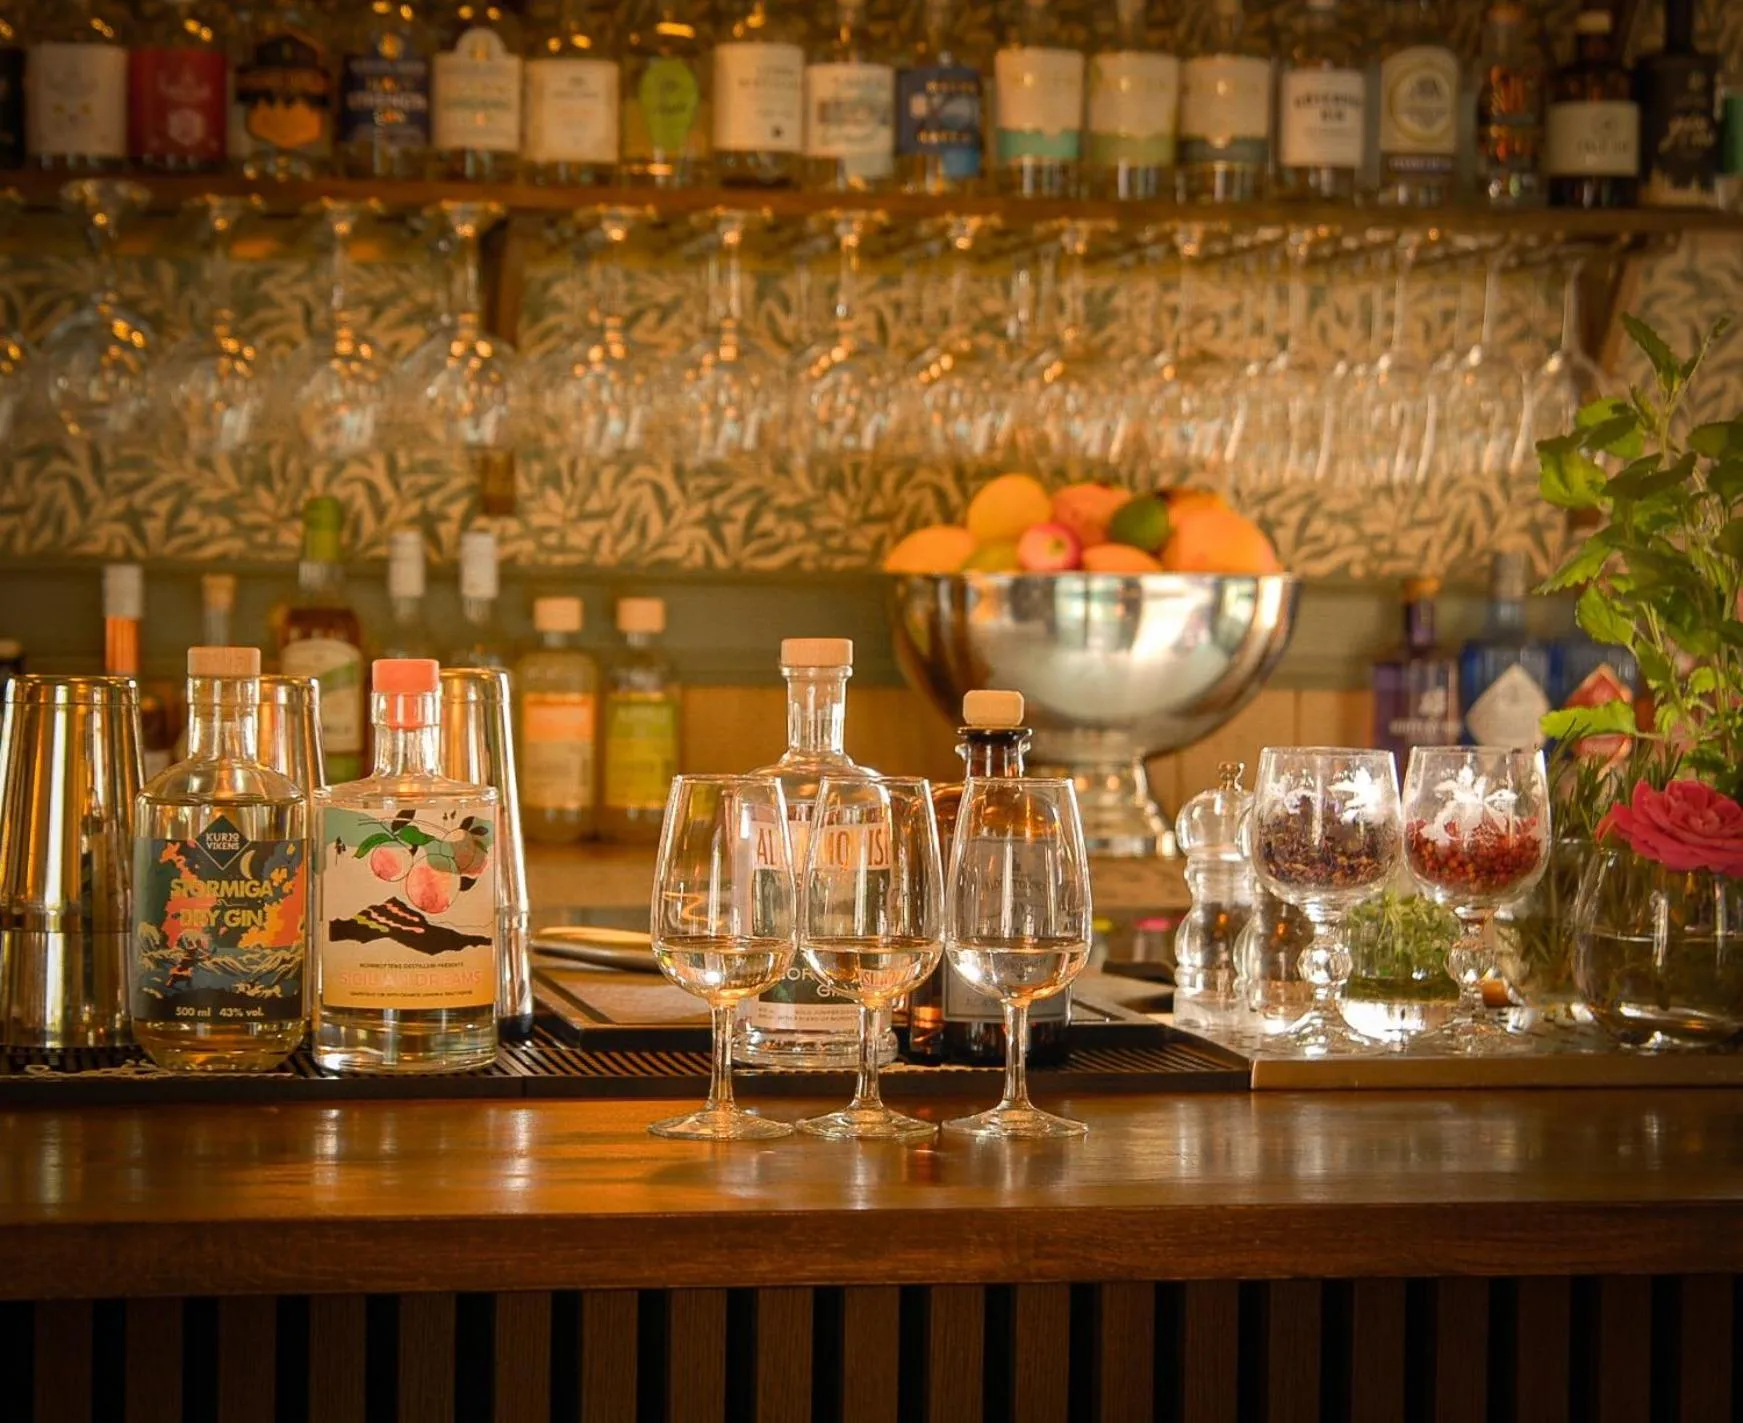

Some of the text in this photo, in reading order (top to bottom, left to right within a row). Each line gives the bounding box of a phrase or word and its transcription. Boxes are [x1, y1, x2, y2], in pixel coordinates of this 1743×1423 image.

[206, 841, 240, 850] VIKENS
[170, 878, 273, 898] STORMIGA
[179, 908, 263, 927] DRY GIN
[415, 969, 484, 987] DREAMS
[175, 1006, 264, 1017] 500 ml 43% vol.
